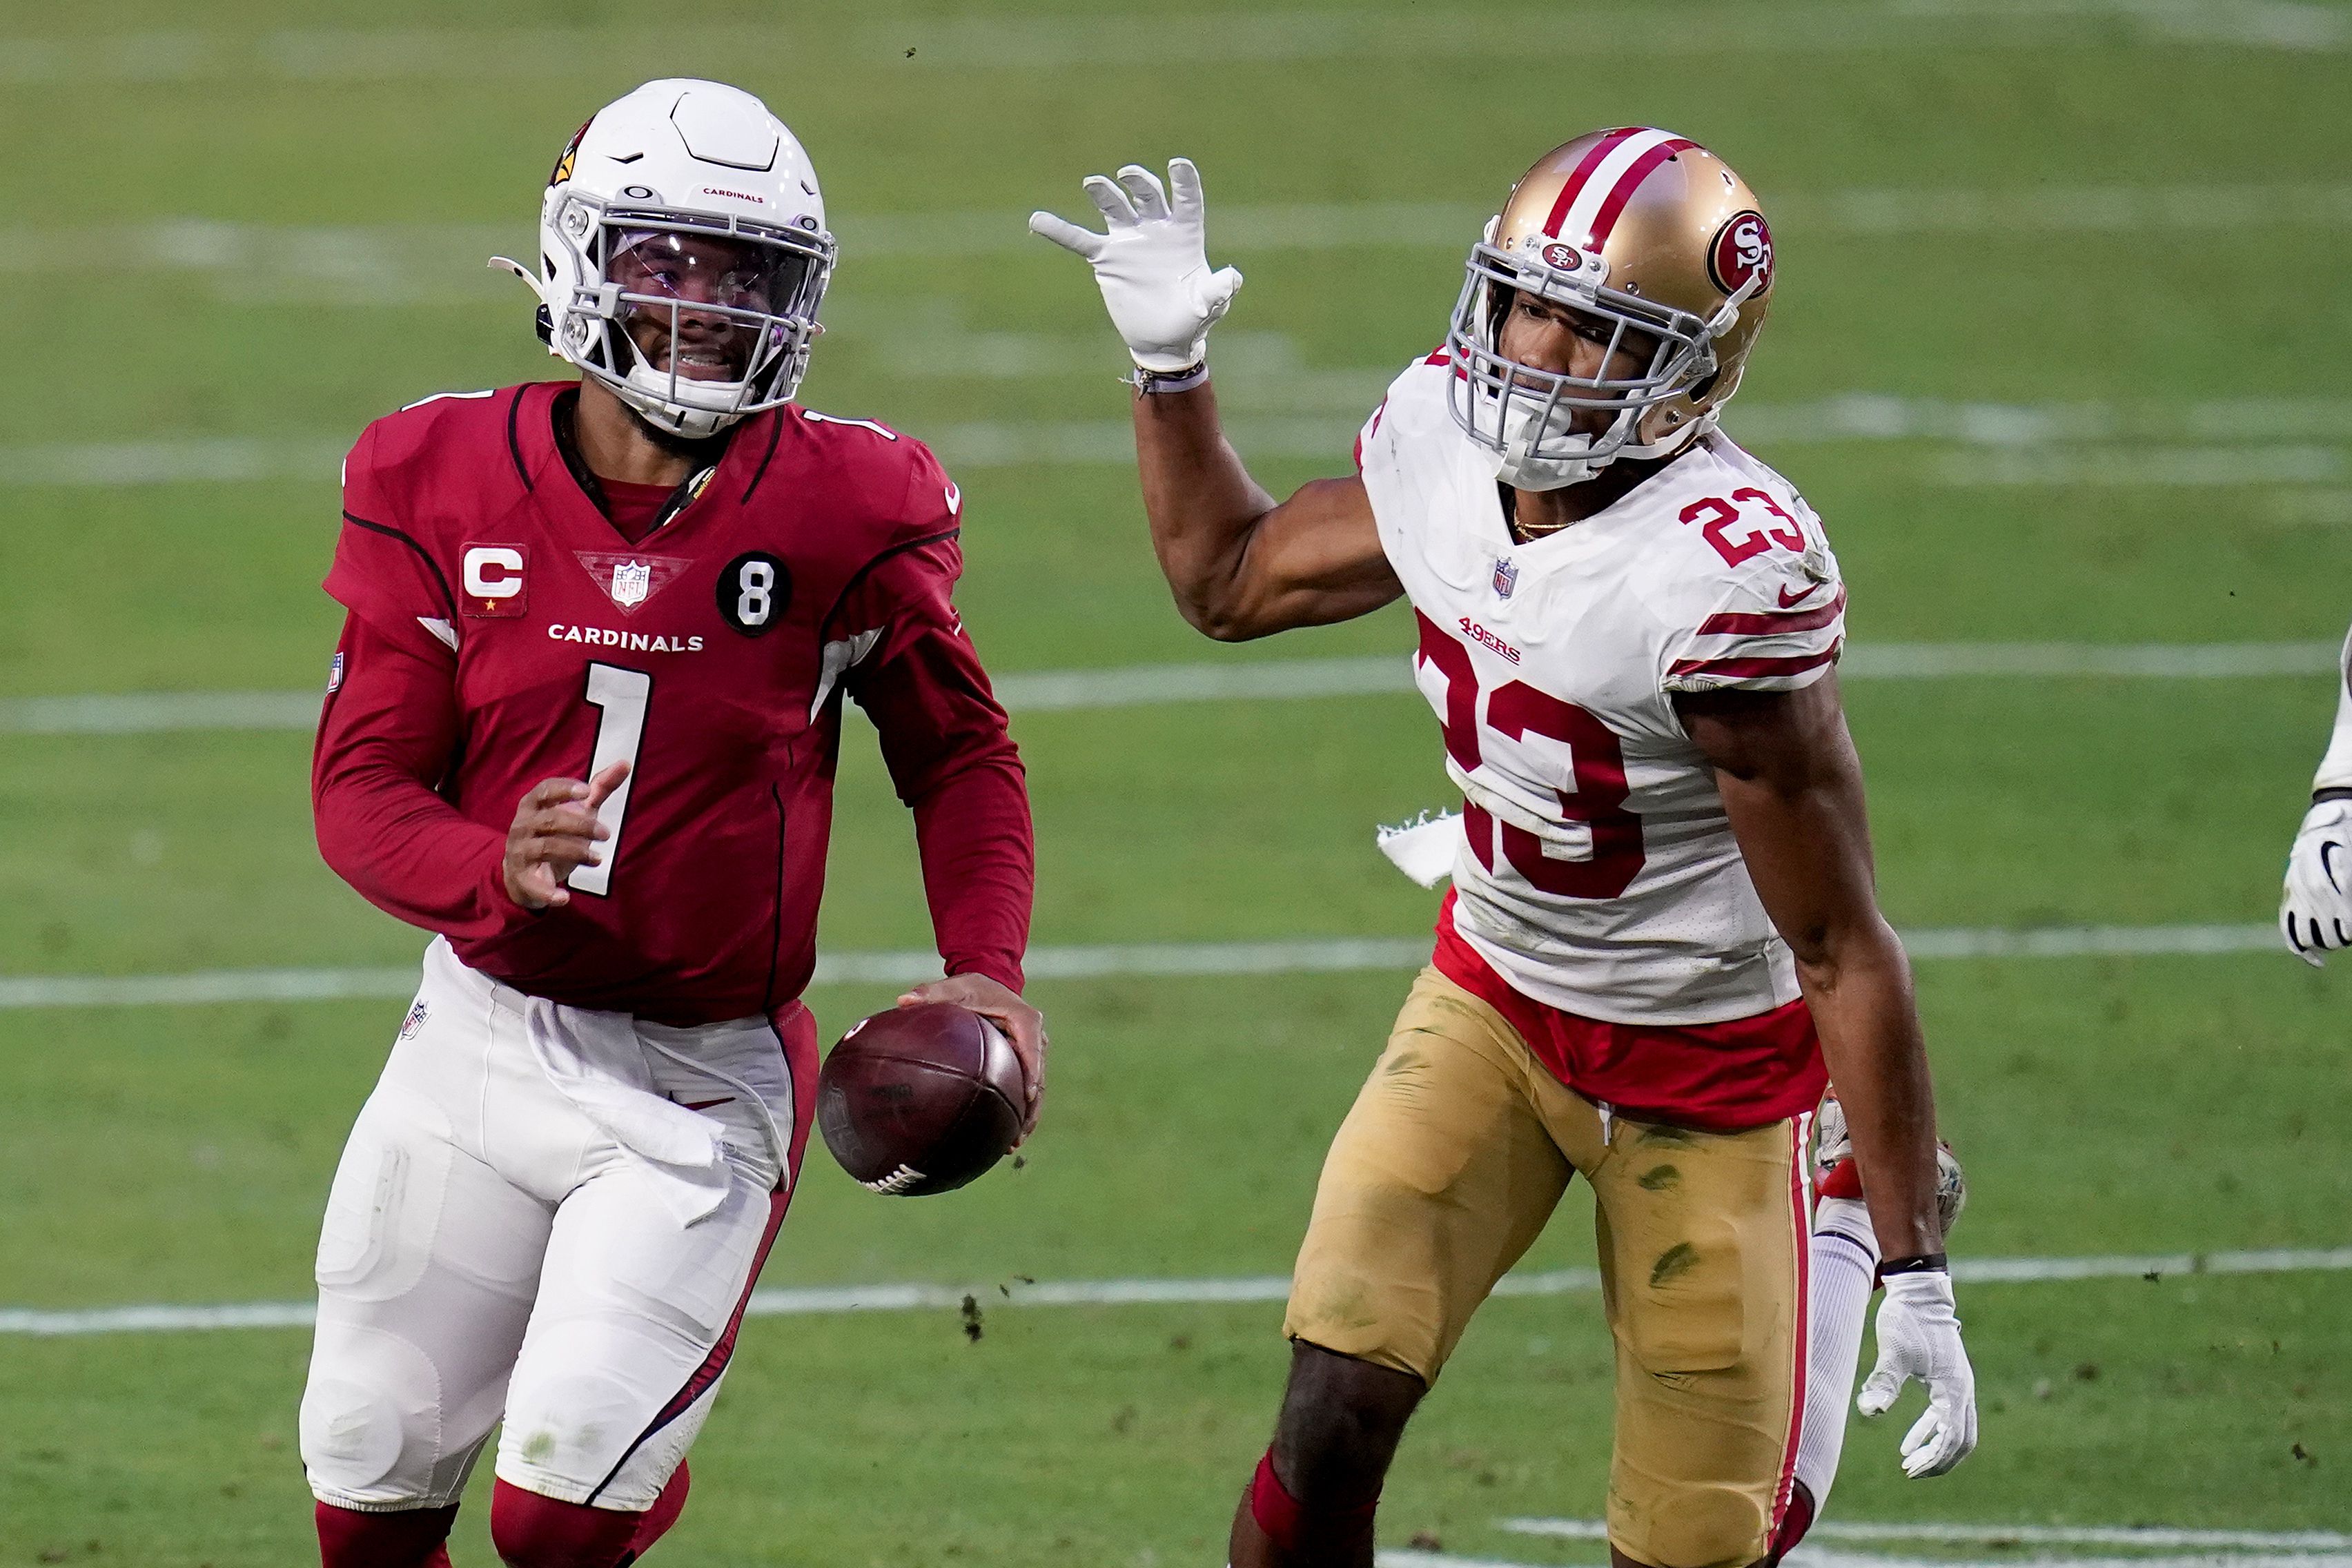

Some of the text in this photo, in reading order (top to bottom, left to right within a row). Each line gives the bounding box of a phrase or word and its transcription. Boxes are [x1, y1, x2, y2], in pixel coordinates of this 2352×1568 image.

[703, 187, 763, 204] CARDINALS
[1551, 246, 1574, 267] SF
[1678, 487, 1805, 569] 23
[463, 548, 523, 598] C
[617, 581, 642, 596] NFL
[738, 561, 774, 625] 8
[1495, 572, 1510, 594] NFL
[548, 624, 704, 652] CARDINALS
[1458, 616, 1521, 663] 49ERS
[1414, 605, 1647, 899] 23
[567, 661, 651, 897] 1
